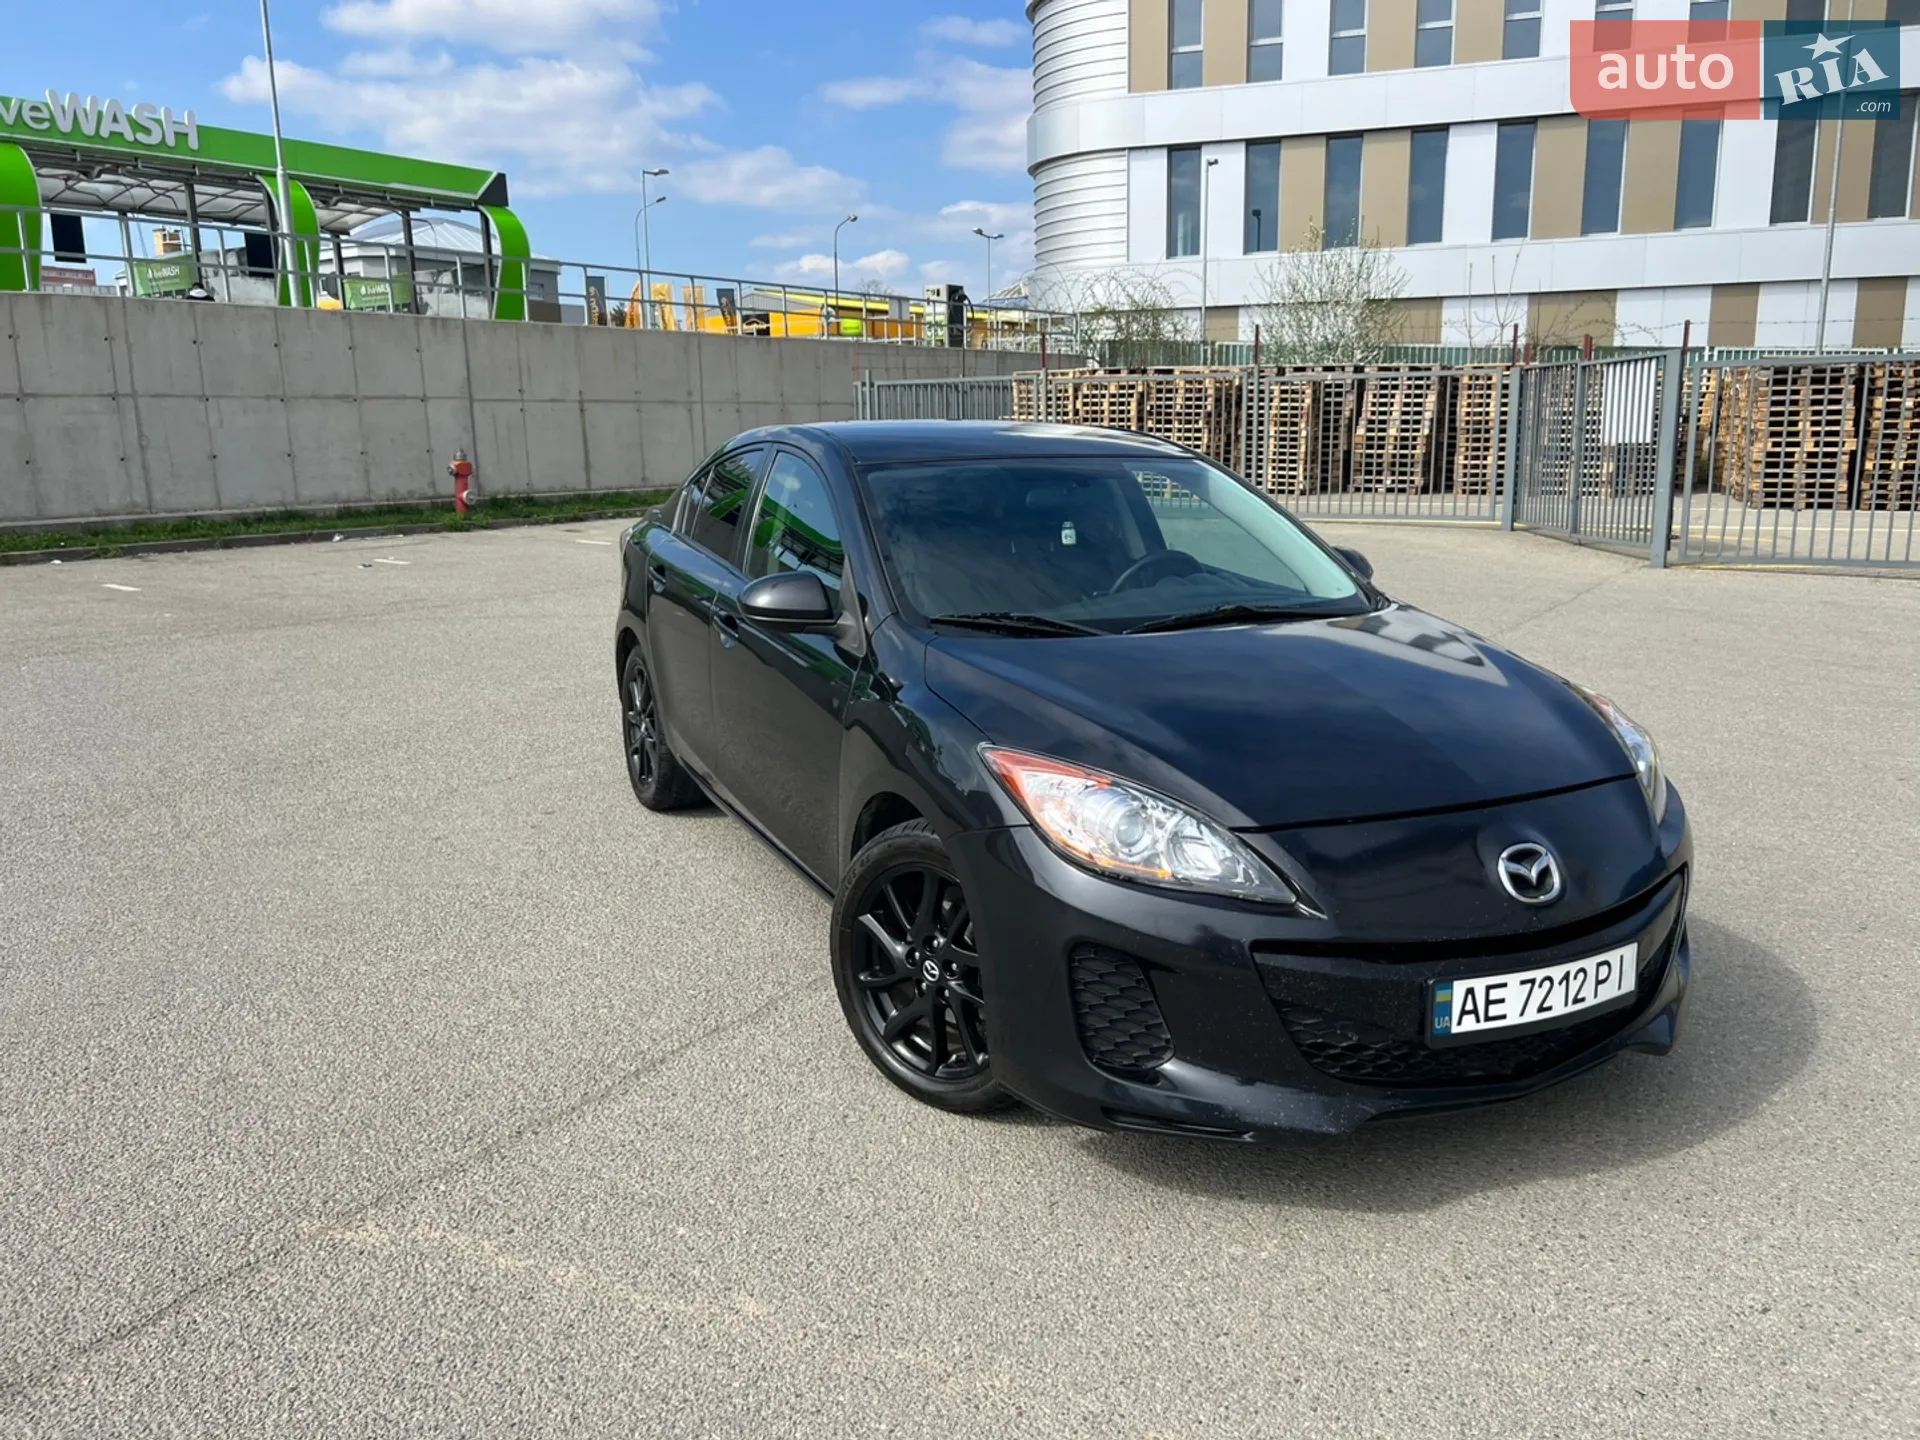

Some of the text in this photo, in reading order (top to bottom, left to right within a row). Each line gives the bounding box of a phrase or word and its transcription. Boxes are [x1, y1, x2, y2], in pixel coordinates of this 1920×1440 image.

[1456, 982, 1508, 1027] AE
[1518, 966, 1588, 1018] 7212
[1435, 1016, 1450, 1029] UA
